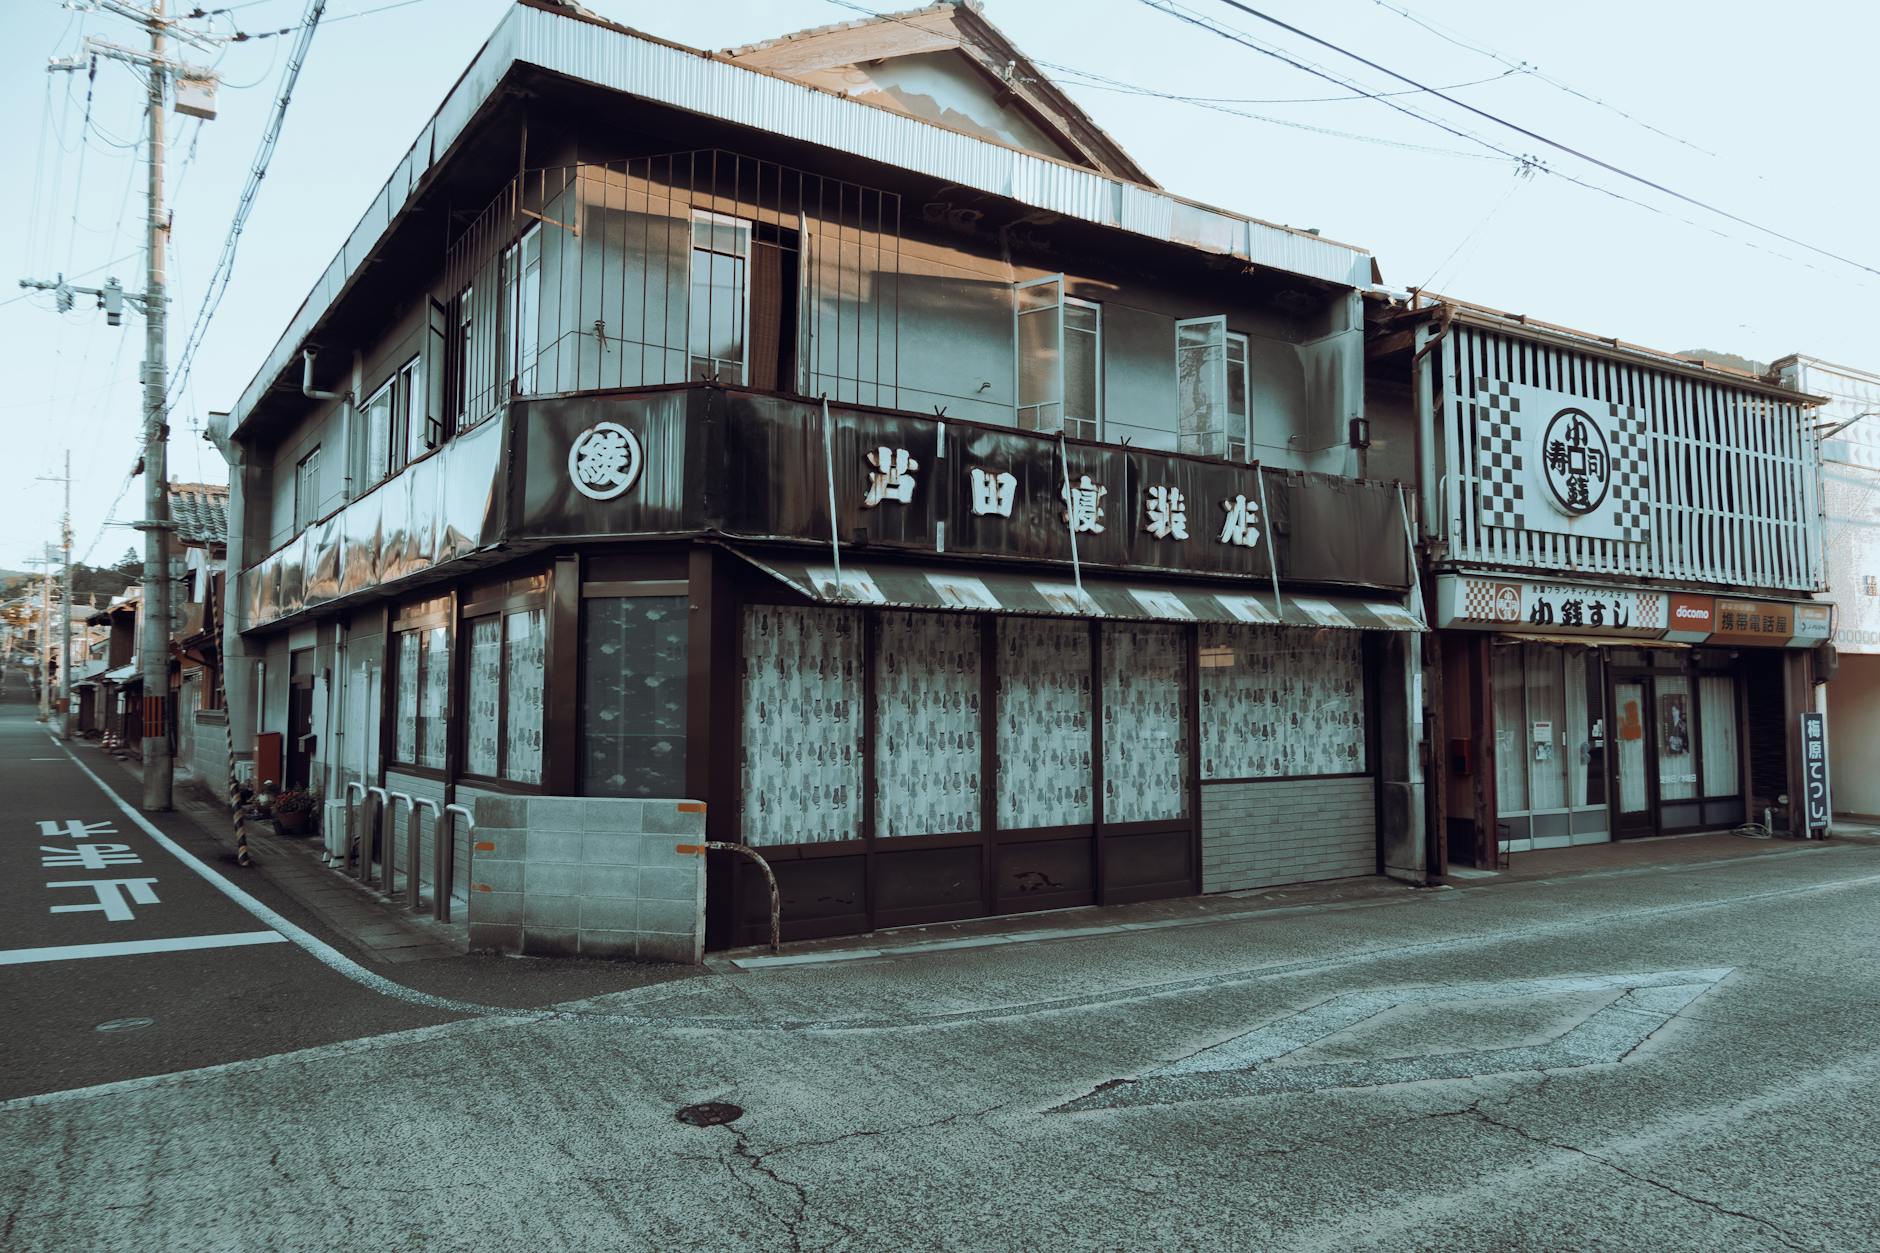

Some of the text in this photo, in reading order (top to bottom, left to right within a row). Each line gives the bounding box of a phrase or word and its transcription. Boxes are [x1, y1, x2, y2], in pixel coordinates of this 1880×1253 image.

[1676, 605, 1710, 619] docomo
[1807, 720, 1824, 819] 梅原てつし
[36, 820, 161, 922] 止まれ
